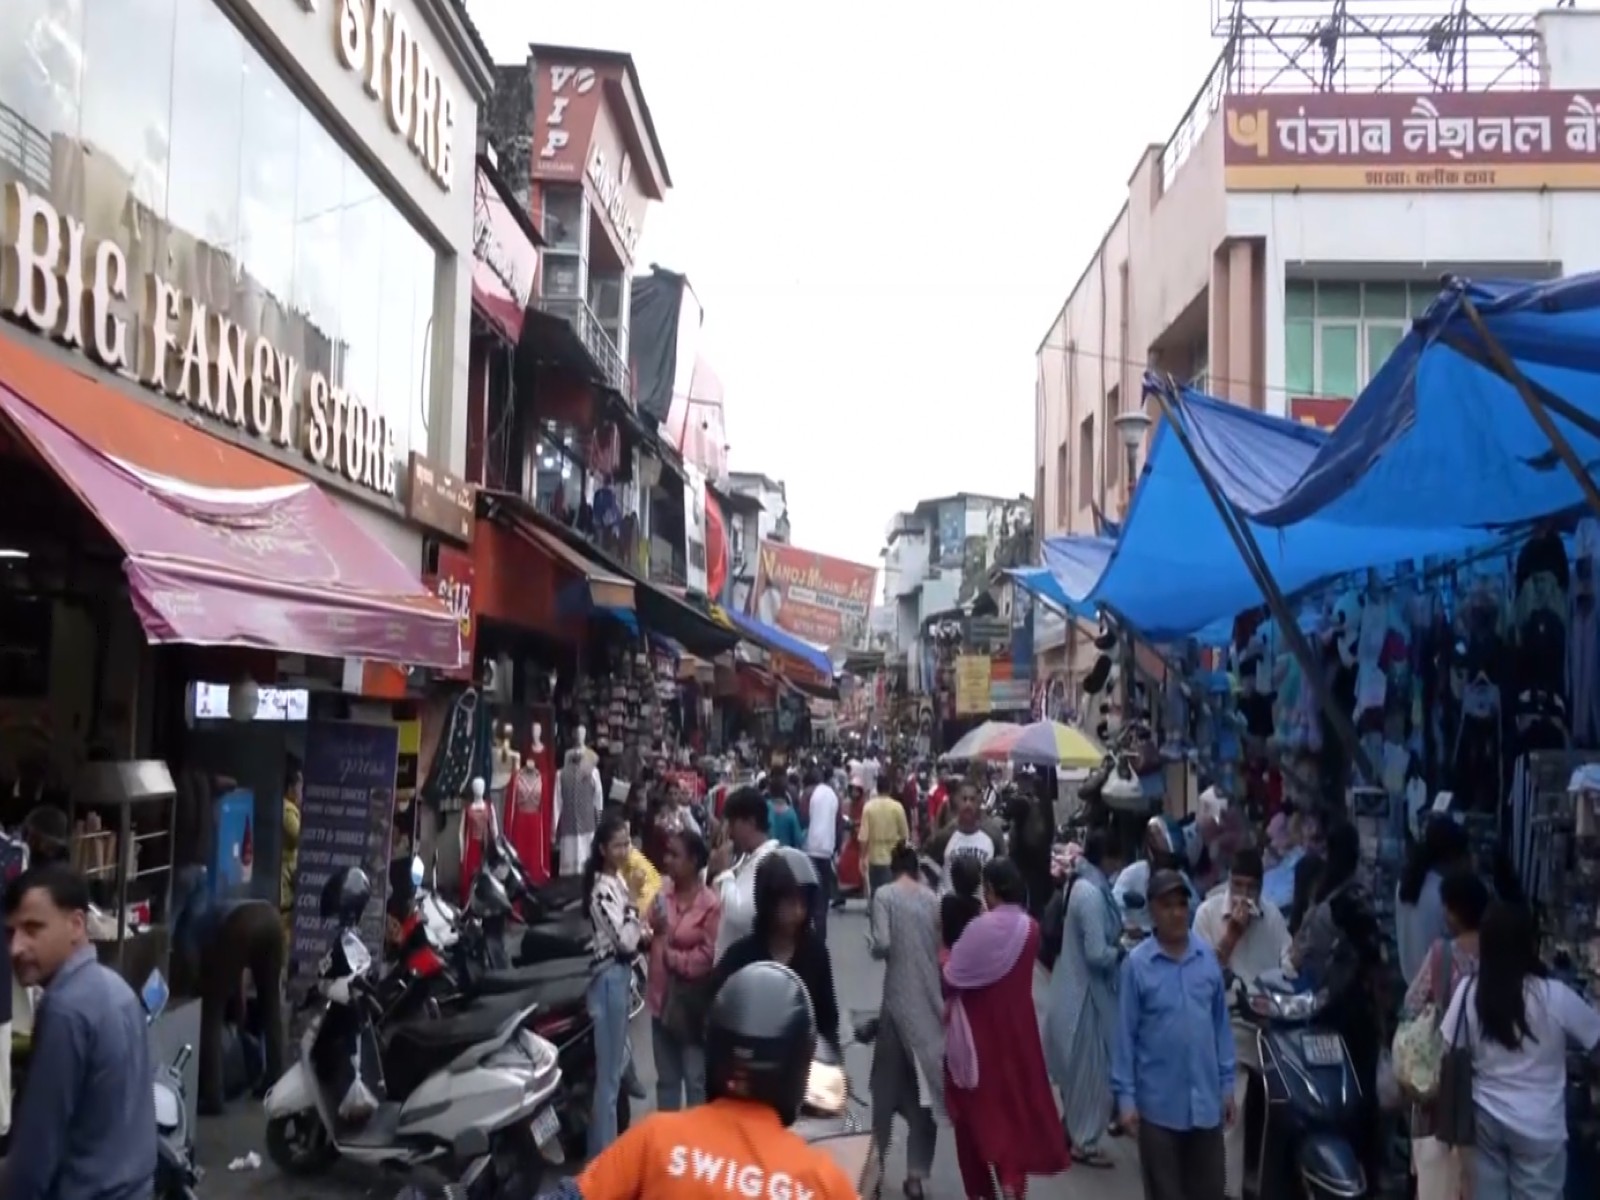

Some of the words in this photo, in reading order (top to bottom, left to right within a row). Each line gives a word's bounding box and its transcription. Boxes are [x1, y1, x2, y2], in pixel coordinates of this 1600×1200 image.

[338, 0, 456, 193] STORE
[1276, 106, 1391, 154] पंजाब
[14, 181, 127, 370] BIG
[151, 274, 299, 442] FANCY
[308, 371, 397, 494] STORE
[667, 1145, 815, 1200] SWIGGY
